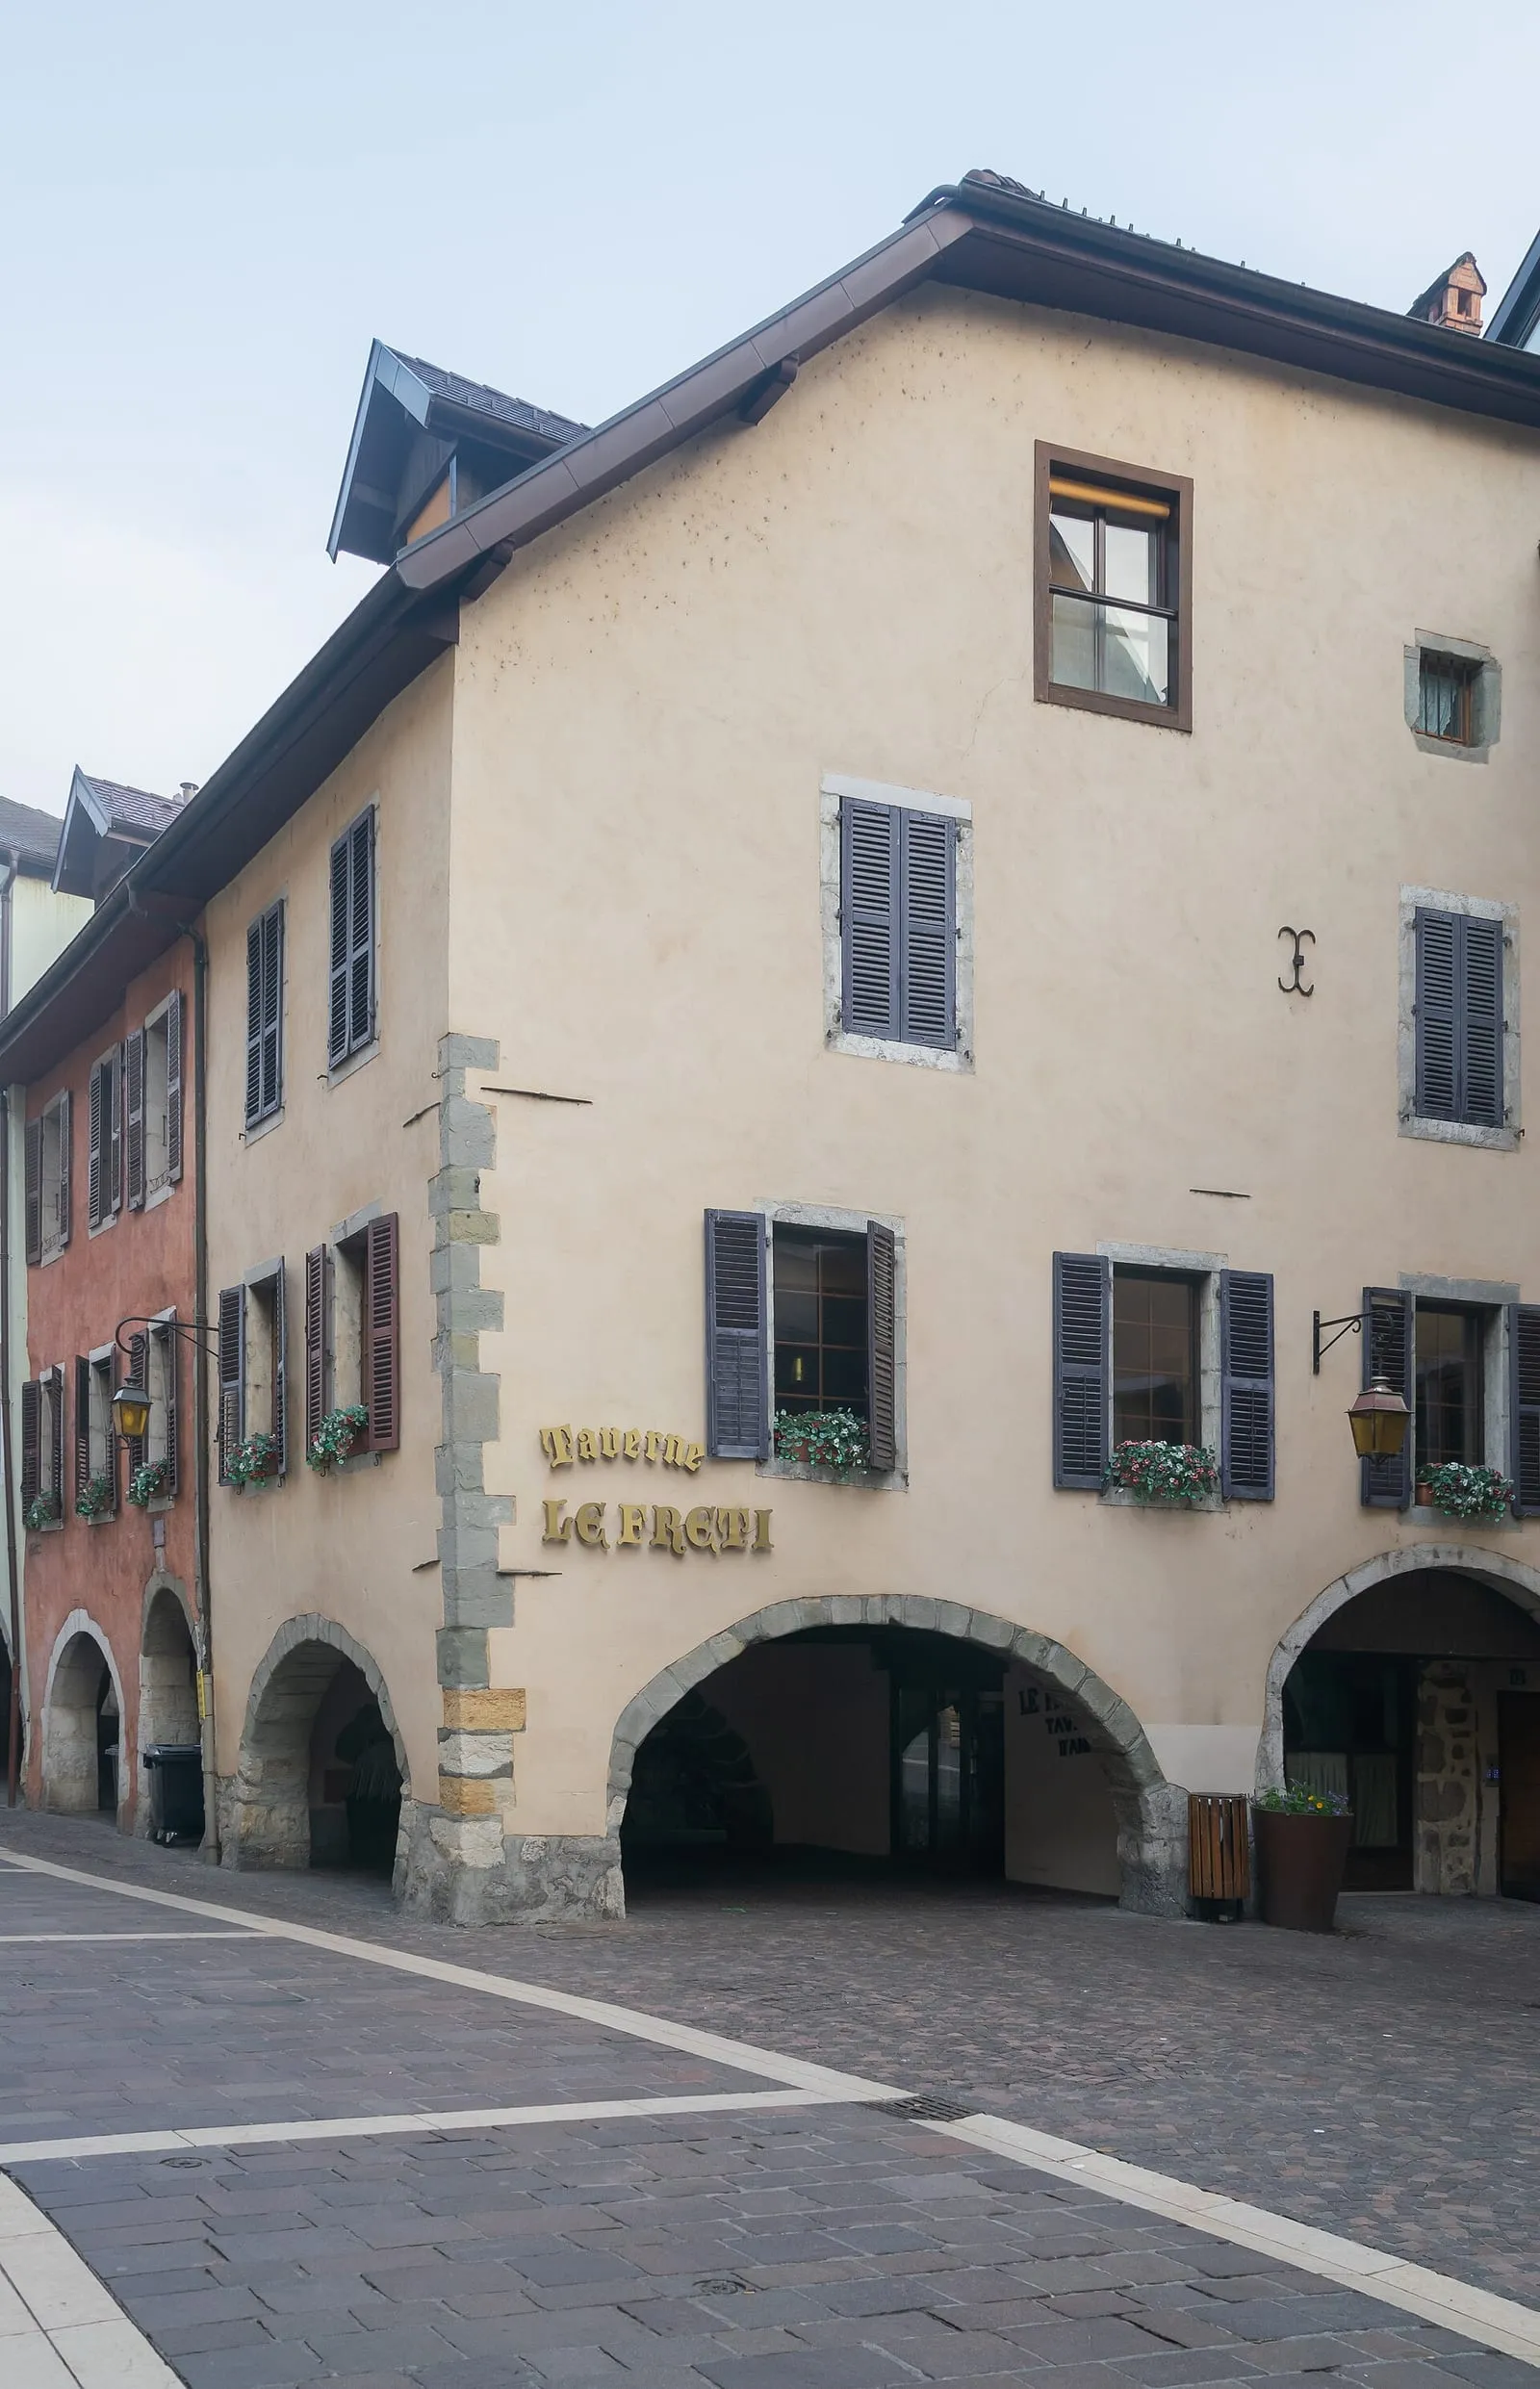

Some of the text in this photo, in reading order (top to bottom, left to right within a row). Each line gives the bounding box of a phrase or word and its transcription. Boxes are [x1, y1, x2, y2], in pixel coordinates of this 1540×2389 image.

[539, 1424, 706, 1472] Taverne
[542, 1499, 775, 1554] LE FRETI
[1018, 1687, 1040, 1715] LE
